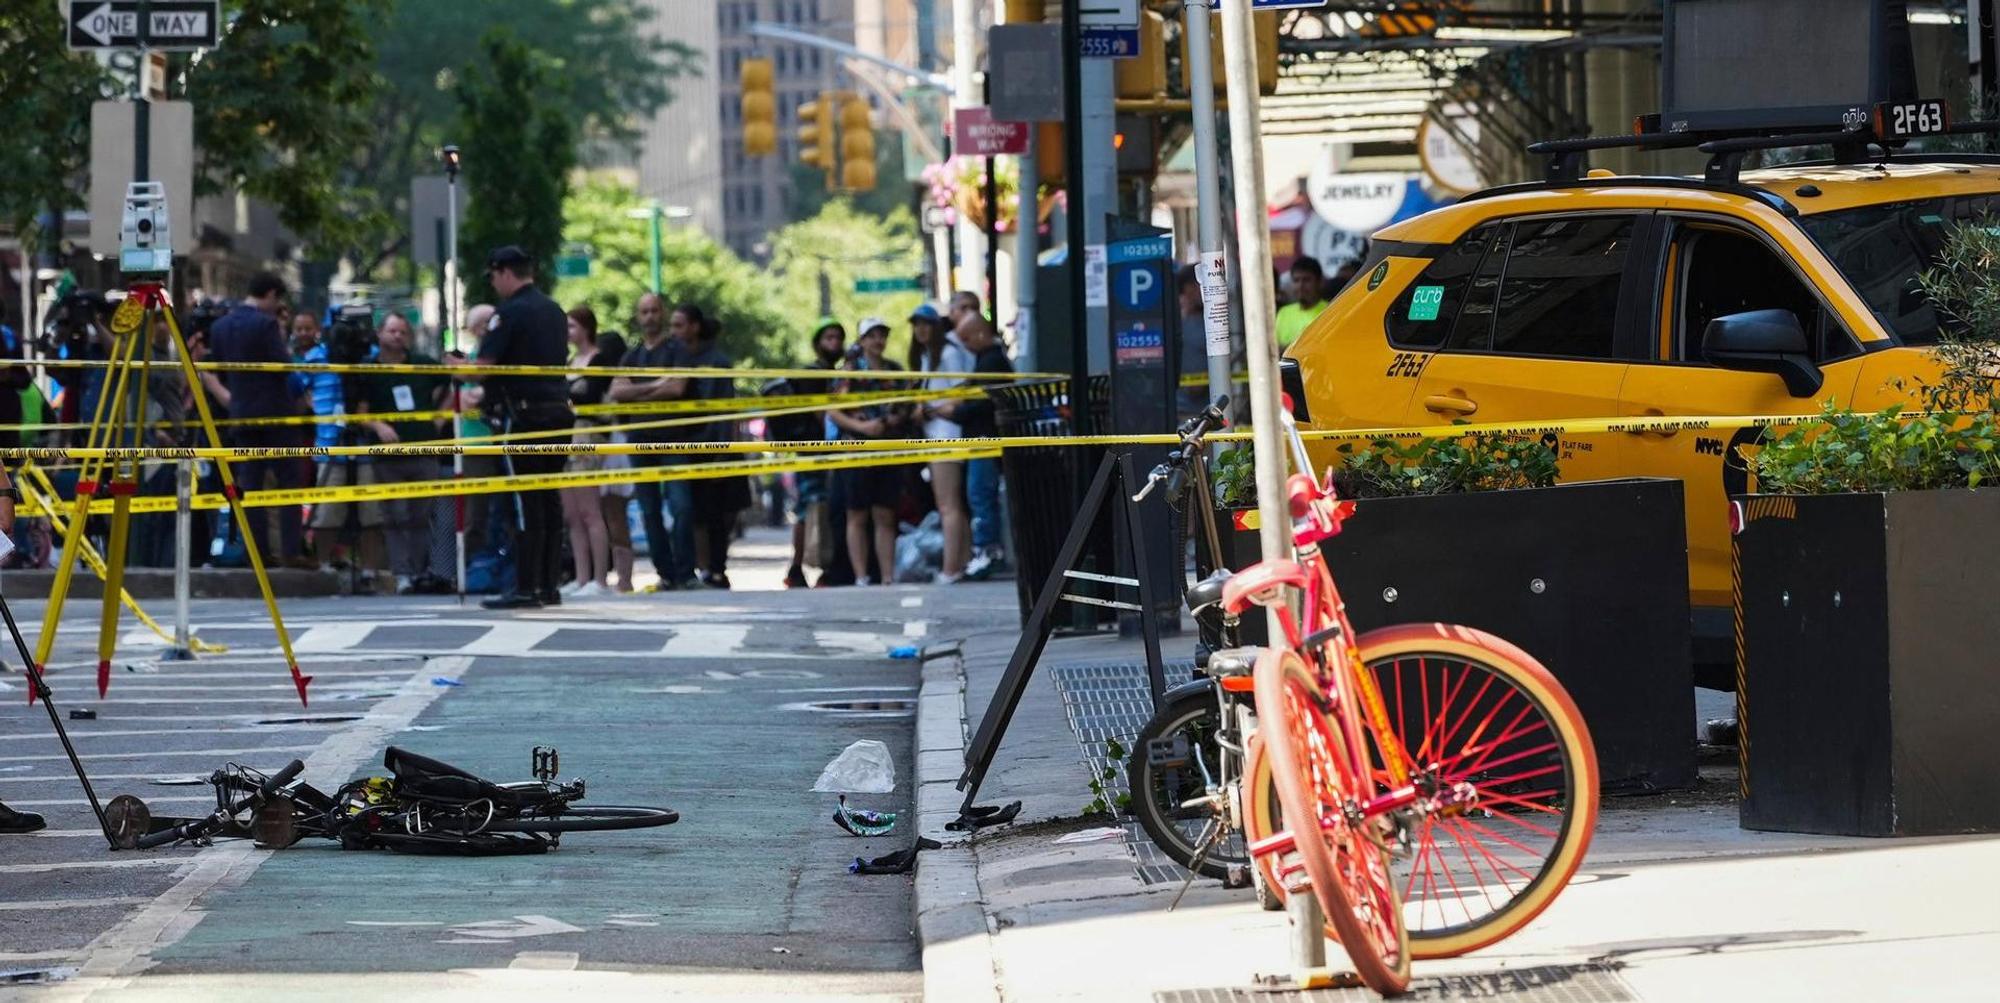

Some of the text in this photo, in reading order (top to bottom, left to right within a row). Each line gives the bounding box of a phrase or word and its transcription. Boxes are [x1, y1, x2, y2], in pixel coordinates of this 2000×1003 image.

[92, 13, 198, 34] ONE WAY
[1893, 103, 1943, 134] 2F63
[968, 124, 1017, 138] WRONG
[977, 139, 1006, 152] WAY
[1322, 183, 1395, 201] JEWELRY
[1122, 243, 1167, 257] 102555
[1129, 268, 1153, 305] P
[1412, 288, 1443, 303] curb
[1117, 335, 1161, 348] 102555
[1386, 353, 1429, 378] 2F63
[1562, 440, 1593, 452] FLAT FARE
[1695, 436, 1724, 456] NYC
